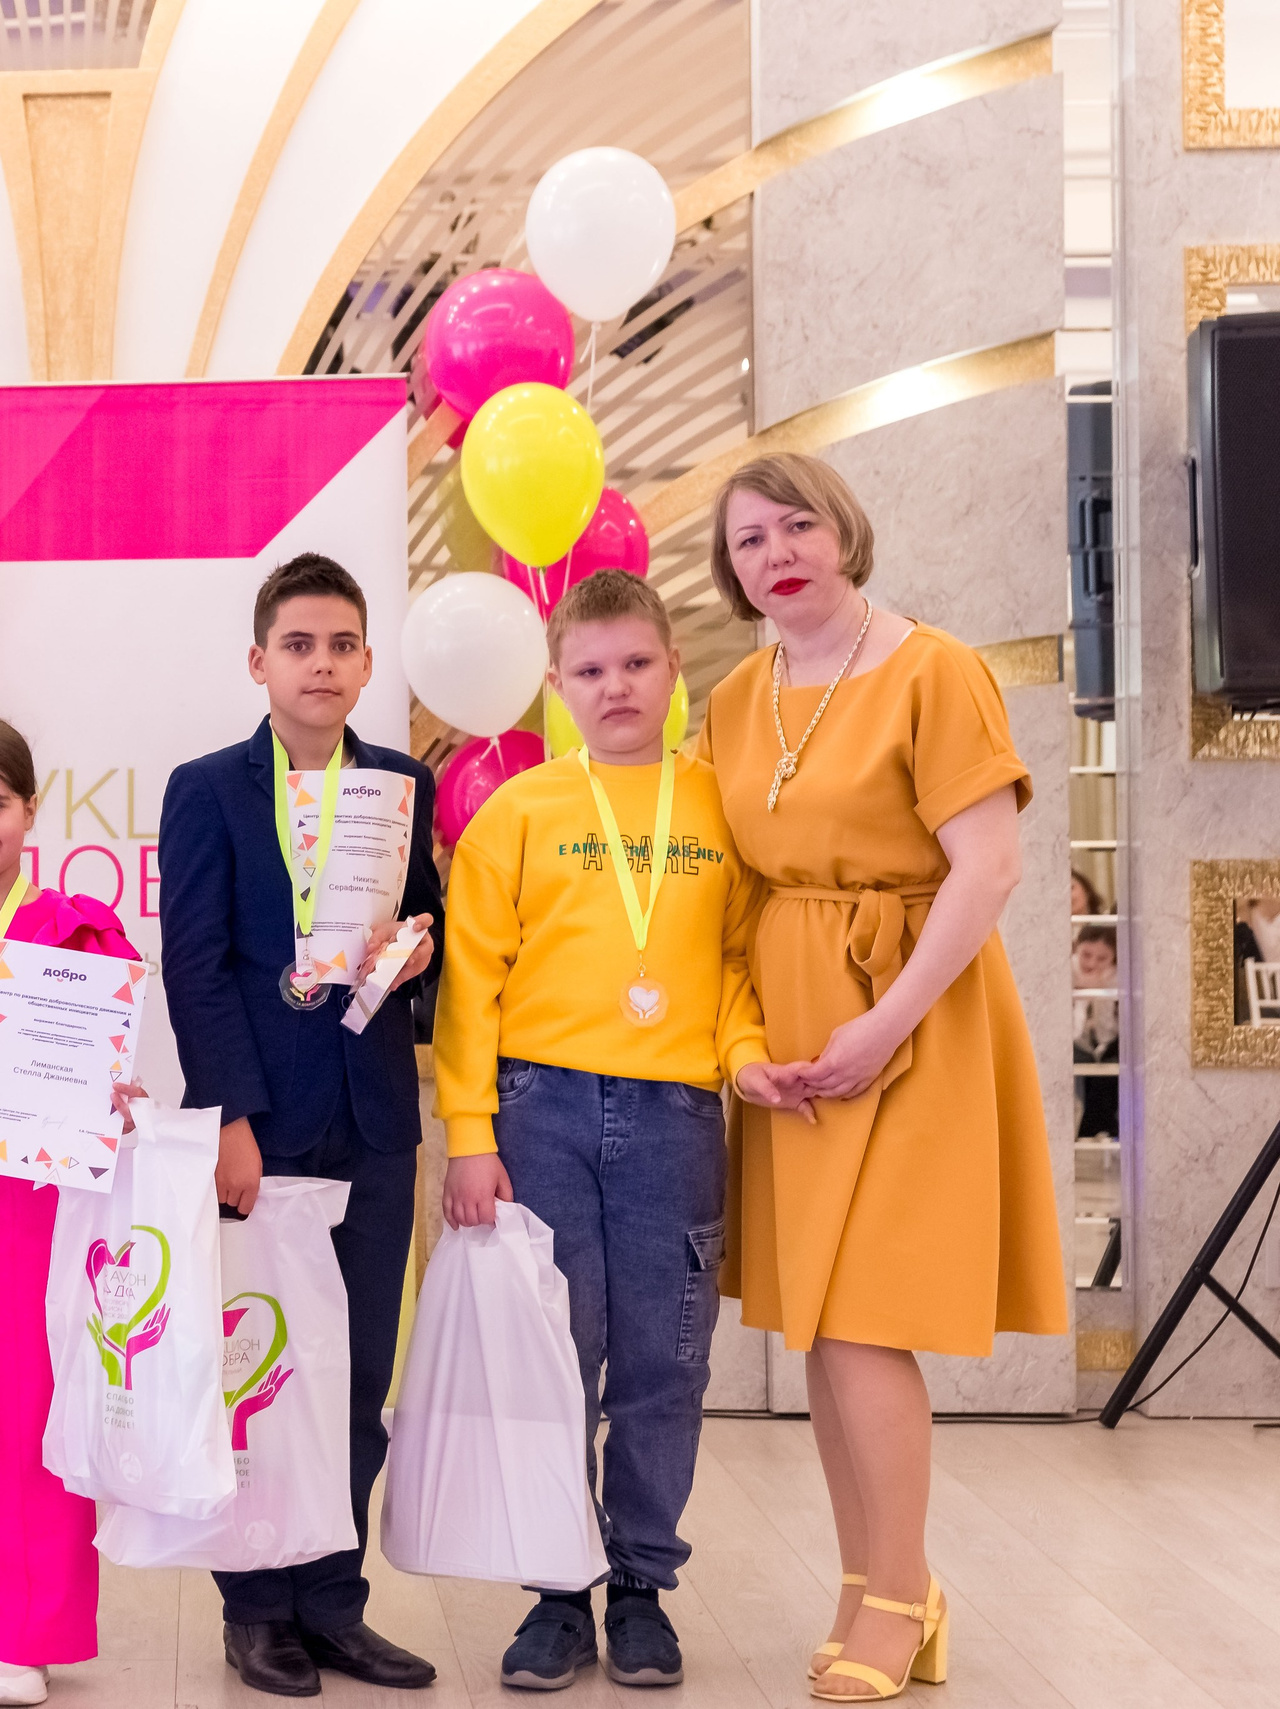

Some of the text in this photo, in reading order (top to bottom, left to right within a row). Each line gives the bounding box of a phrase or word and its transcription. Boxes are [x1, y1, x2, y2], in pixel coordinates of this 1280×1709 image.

[342, 785, 381, 797] добро
[583, 833, 602, 870] A
[328, 883, 364, 893] Серафим
[43, 968, 87, 982] добро
[21, 994, 48, 1003] развитию
[30, 1059, 74, 1073] Лиманская
[13, 1066, 88, 1086] Стелла Джаниевна
